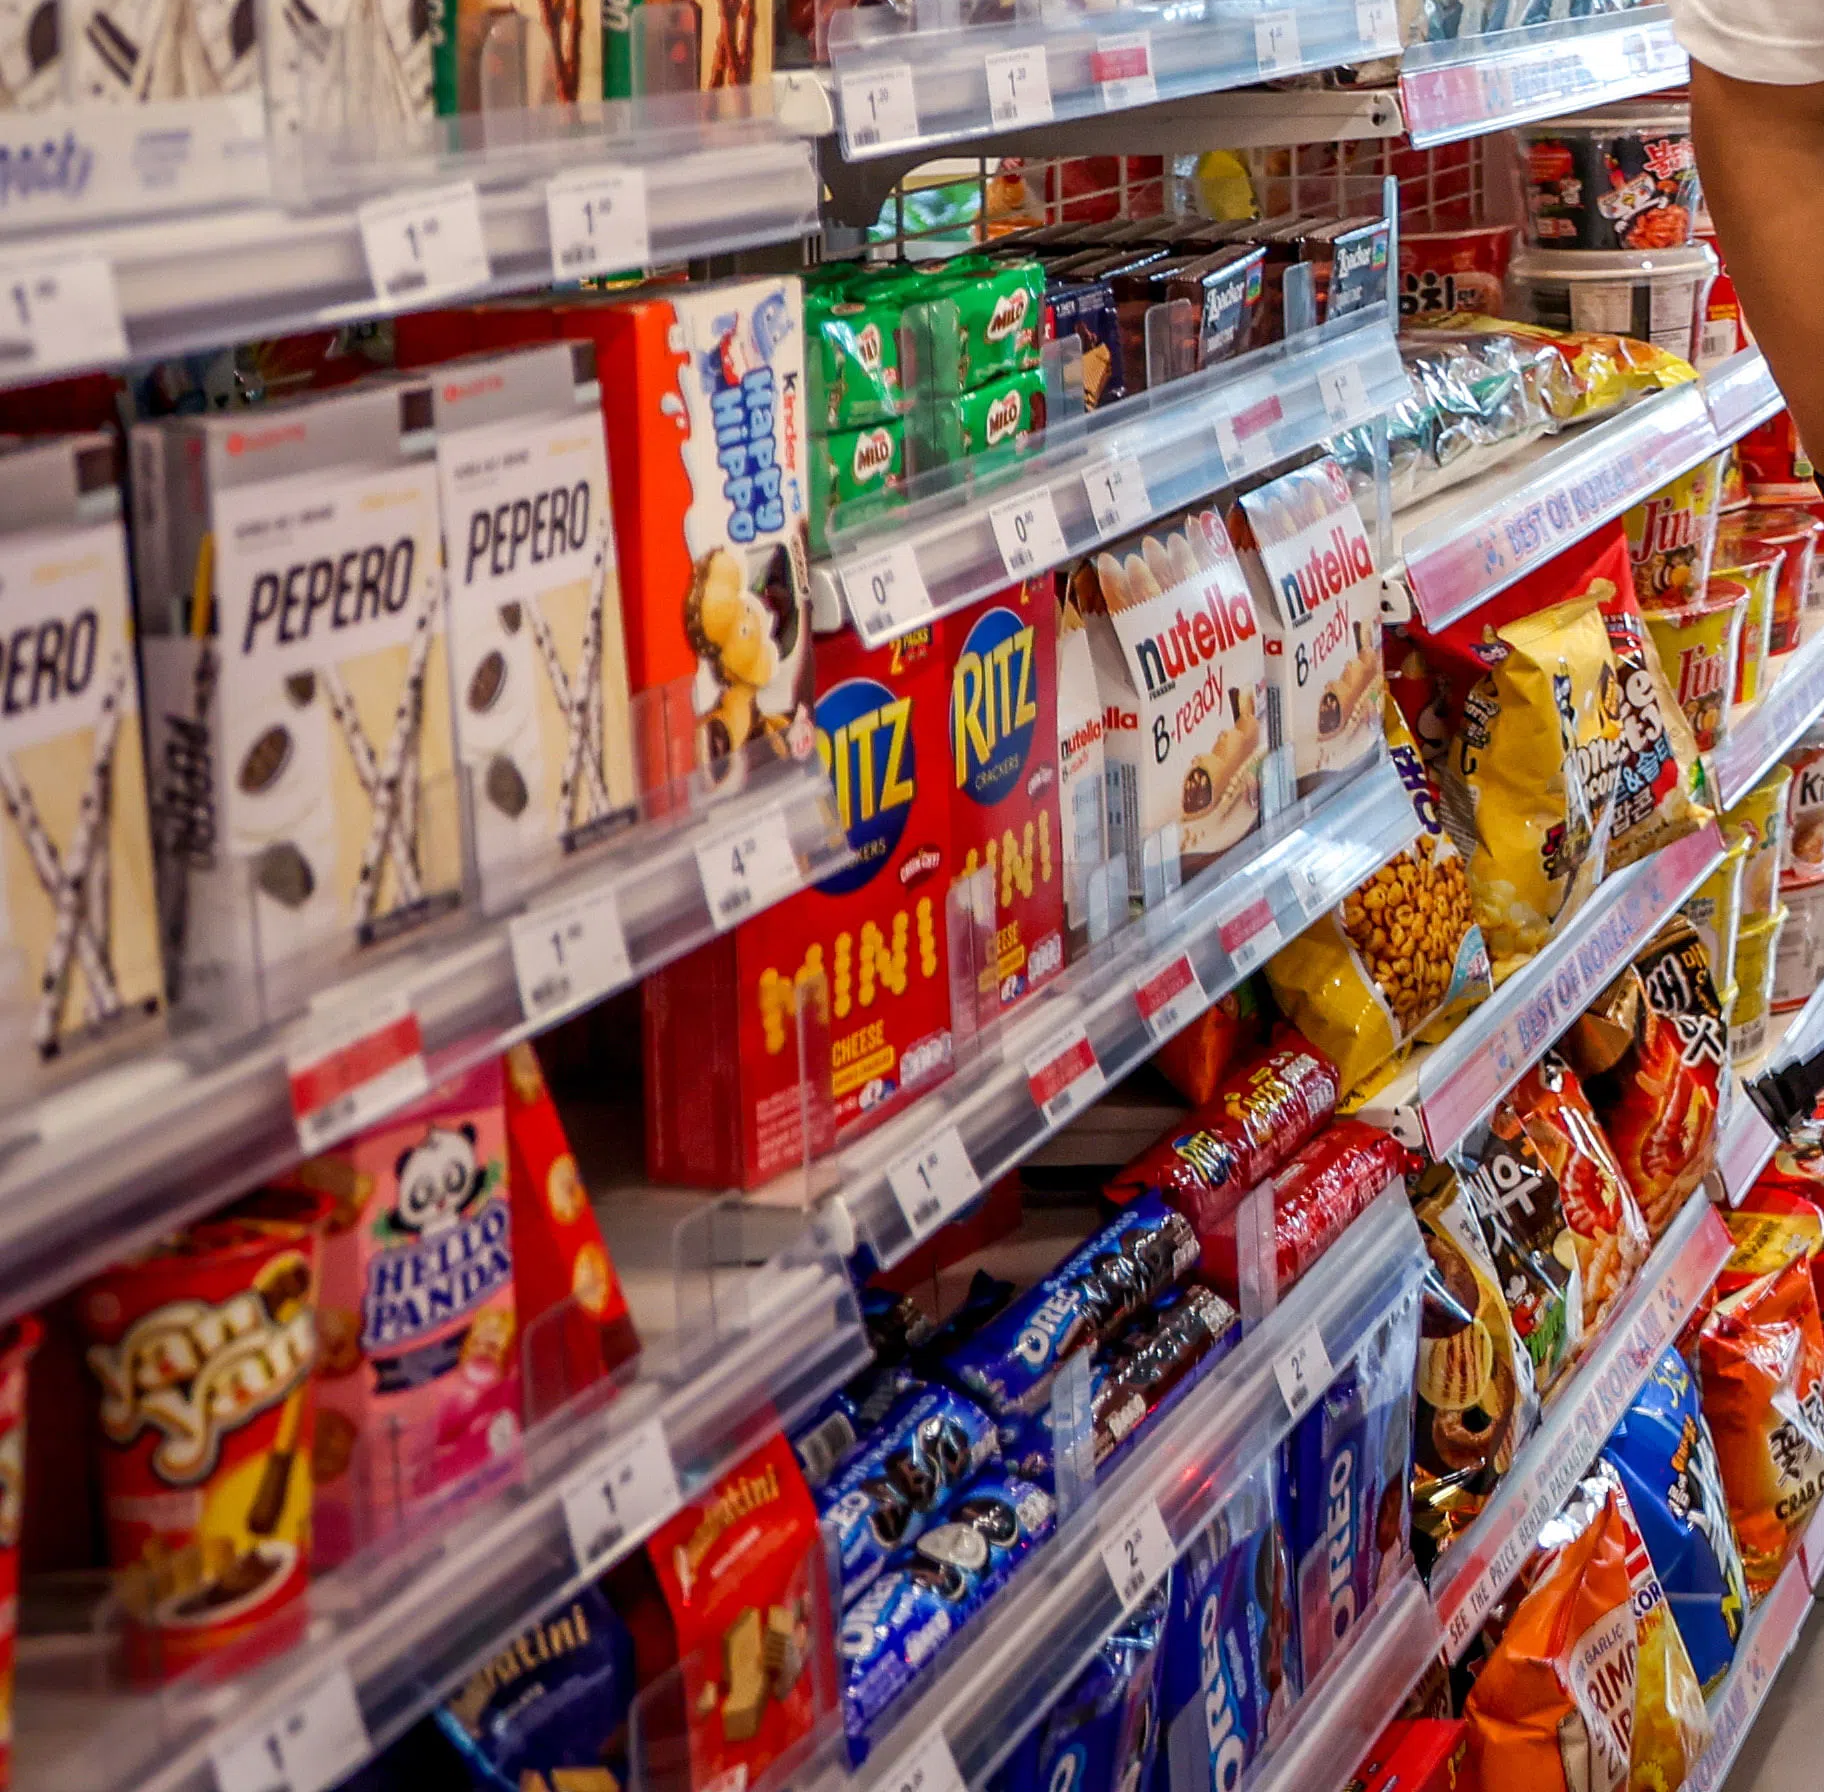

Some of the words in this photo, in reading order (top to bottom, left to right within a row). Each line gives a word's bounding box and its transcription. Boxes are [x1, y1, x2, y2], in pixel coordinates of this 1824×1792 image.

[990, 302, 1024, 334] MILO
[711, 386, 757, 544] Hippo
[741, 365, 786, 533] Happy
[782, 371, 799, 473] Kinder
[857, 442, 889, 472] MILO
[989, 405, 1018, 436] MILO
[466, 480, 590, 586] PEPERO
[1279, 525, 1374, 620] nutella
[1505, 506, 1547, 556] BEST
[1632, 496, 1693, 565] Jin
[242, 537, 415, 657] PEPERO
[1134, 583, 1256, 692] nutella
[1295, 599, 1351, 687] B-ready
[1677, 644, 1724, 706] Jin
[953, 624, 1036, 790] RITZ
[1061, 717, 1102, 760] nutella
[1153, 664, 1225, 764] B-ready
[975, 751, 1020, 792] CRACKERS
[759, 896, 937, 1055] MINI
[1517, 983, 1557, 1050] BEST
[832, 1018, 885, 1068] CHEESE
[370, 1248, 510, 1343] PANDA
[374, 1210, 508, 1298] HELLO
[1329, 1448, 1356, 1641] OREO
[1449, 1617, 1470, 1646] SEE
[1470, 1586, 1491, 1614] THE
[1488, 1541, 1519, 1585] PRICE
[1518, 1502, 1550, 1552] BEHIND
[1550, 1432, 1594, 1503] PACKAGING
[1775, 1483, 1818, 1522] CRAB
[1583, 1621, 1625, 1666] GARLIC
[1201, 1593, 1245, 1792] OREO
